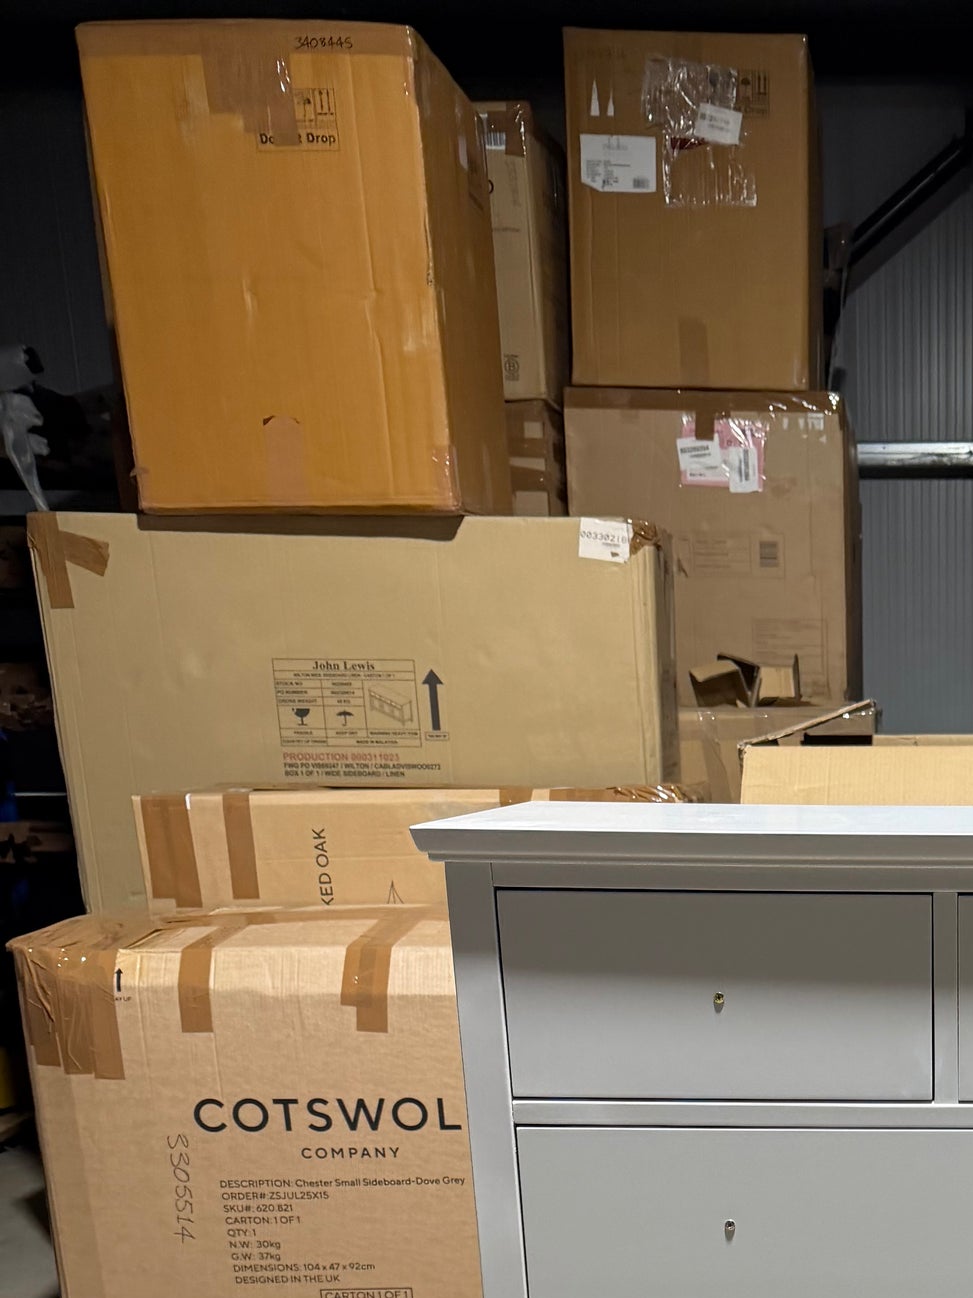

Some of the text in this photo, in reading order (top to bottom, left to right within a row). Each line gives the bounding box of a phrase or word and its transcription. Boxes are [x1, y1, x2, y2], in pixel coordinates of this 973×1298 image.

[306, 132, 336, 146] Drop
[312, 661, 375, 671] John Lewis
[283, 753, 348, 762] PRODUCTION
[311, 829, 329, 868] OAK
[193, 1097, 463, 1132] COTSWOL
[301, 1147, 400, 1159] COMPANY
[219, 1176, 465, 1189] DESCRIPTION: Chester Small Sideboard-Dove Grey
[166, 1134, 197, 1244] 3305514
[256, 1240, 281, 1250] 30kg
[258, 1252, 281, 1262] 37kg
[303, 1263, 320, 1271] 104
[329, 1263, 340, 1271] 47
[349, 1262, 376, 1271] 92cm
[235, 1275, 289, 1284] DESIGNED
[290, 1275, 301, 1283] IN
[303, 1275, 323, 1283] THE
